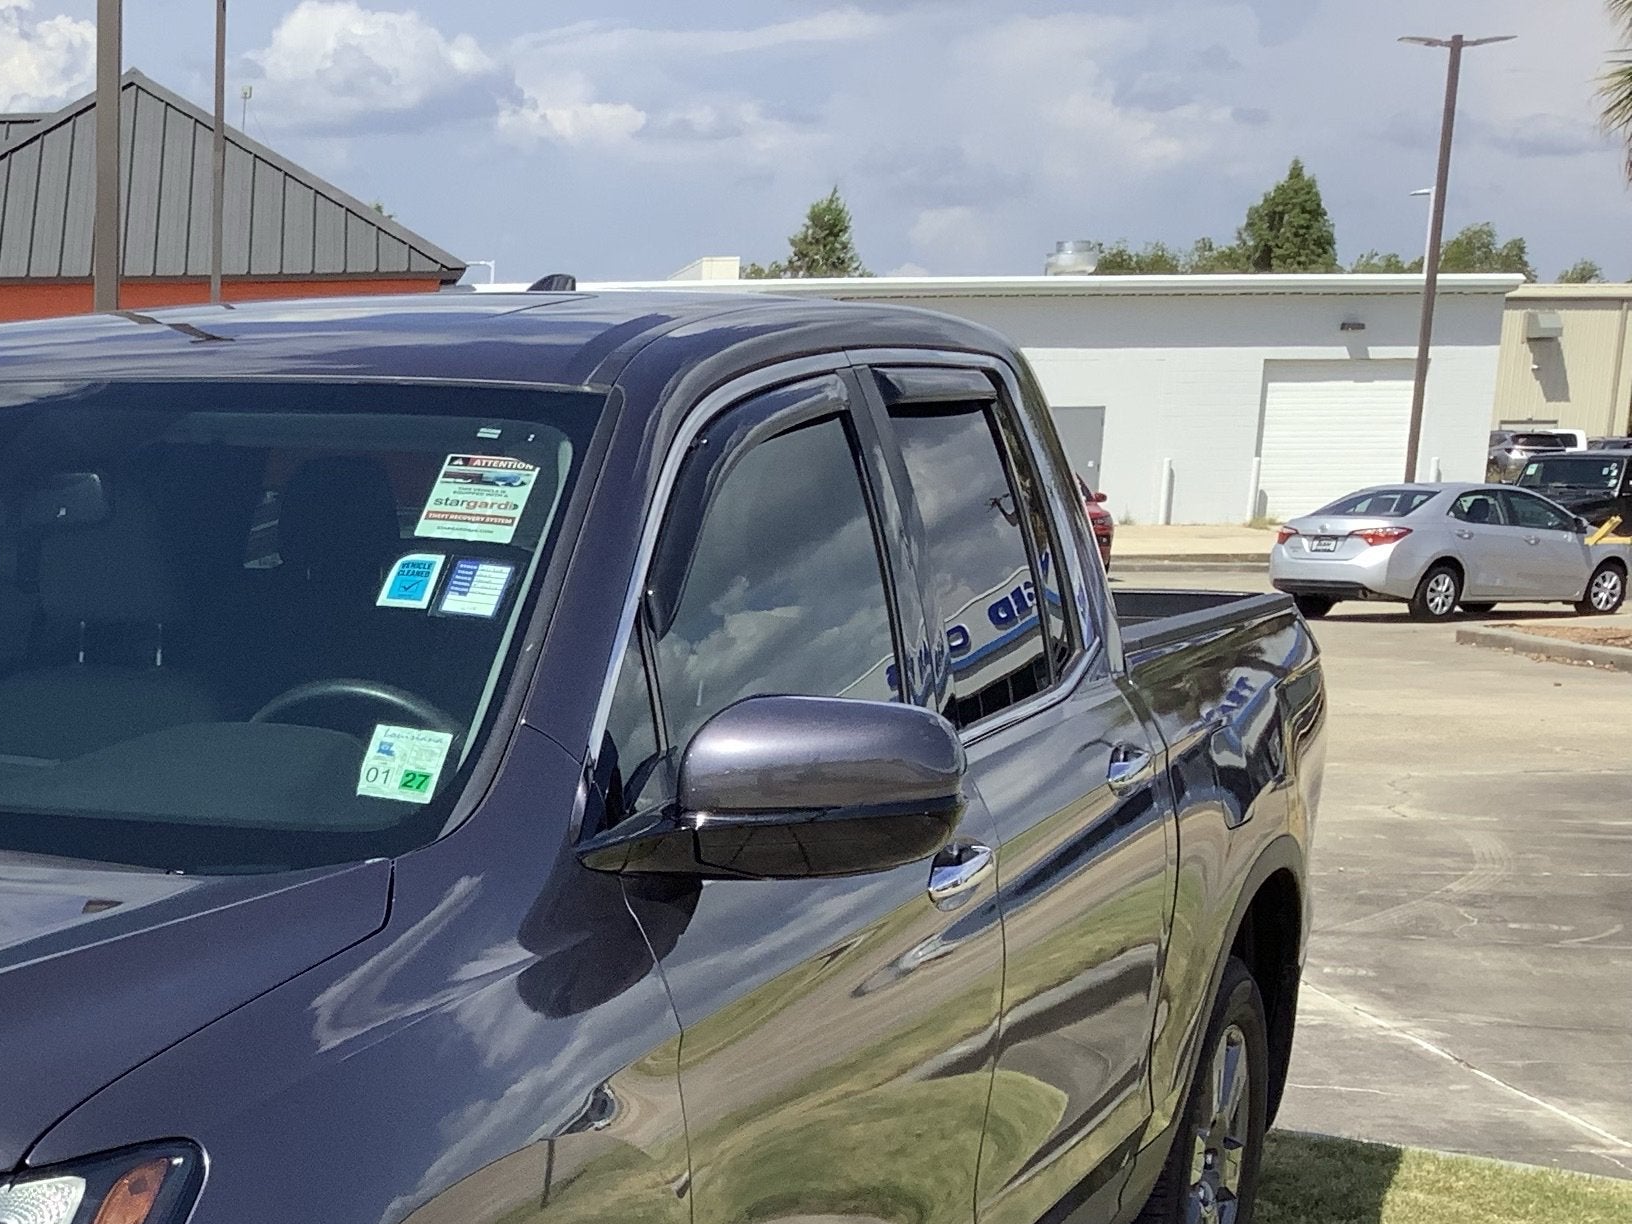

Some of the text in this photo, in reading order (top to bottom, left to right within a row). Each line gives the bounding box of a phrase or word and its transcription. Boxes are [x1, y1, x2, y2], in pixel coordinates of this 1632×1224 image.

[472, 458, 534, 470] ATTENTION
[401, 562, 433, 570] VEHICLE
[397, 569, 431, 577] CLEANED
[365, 767, 430, 790] 01 27
